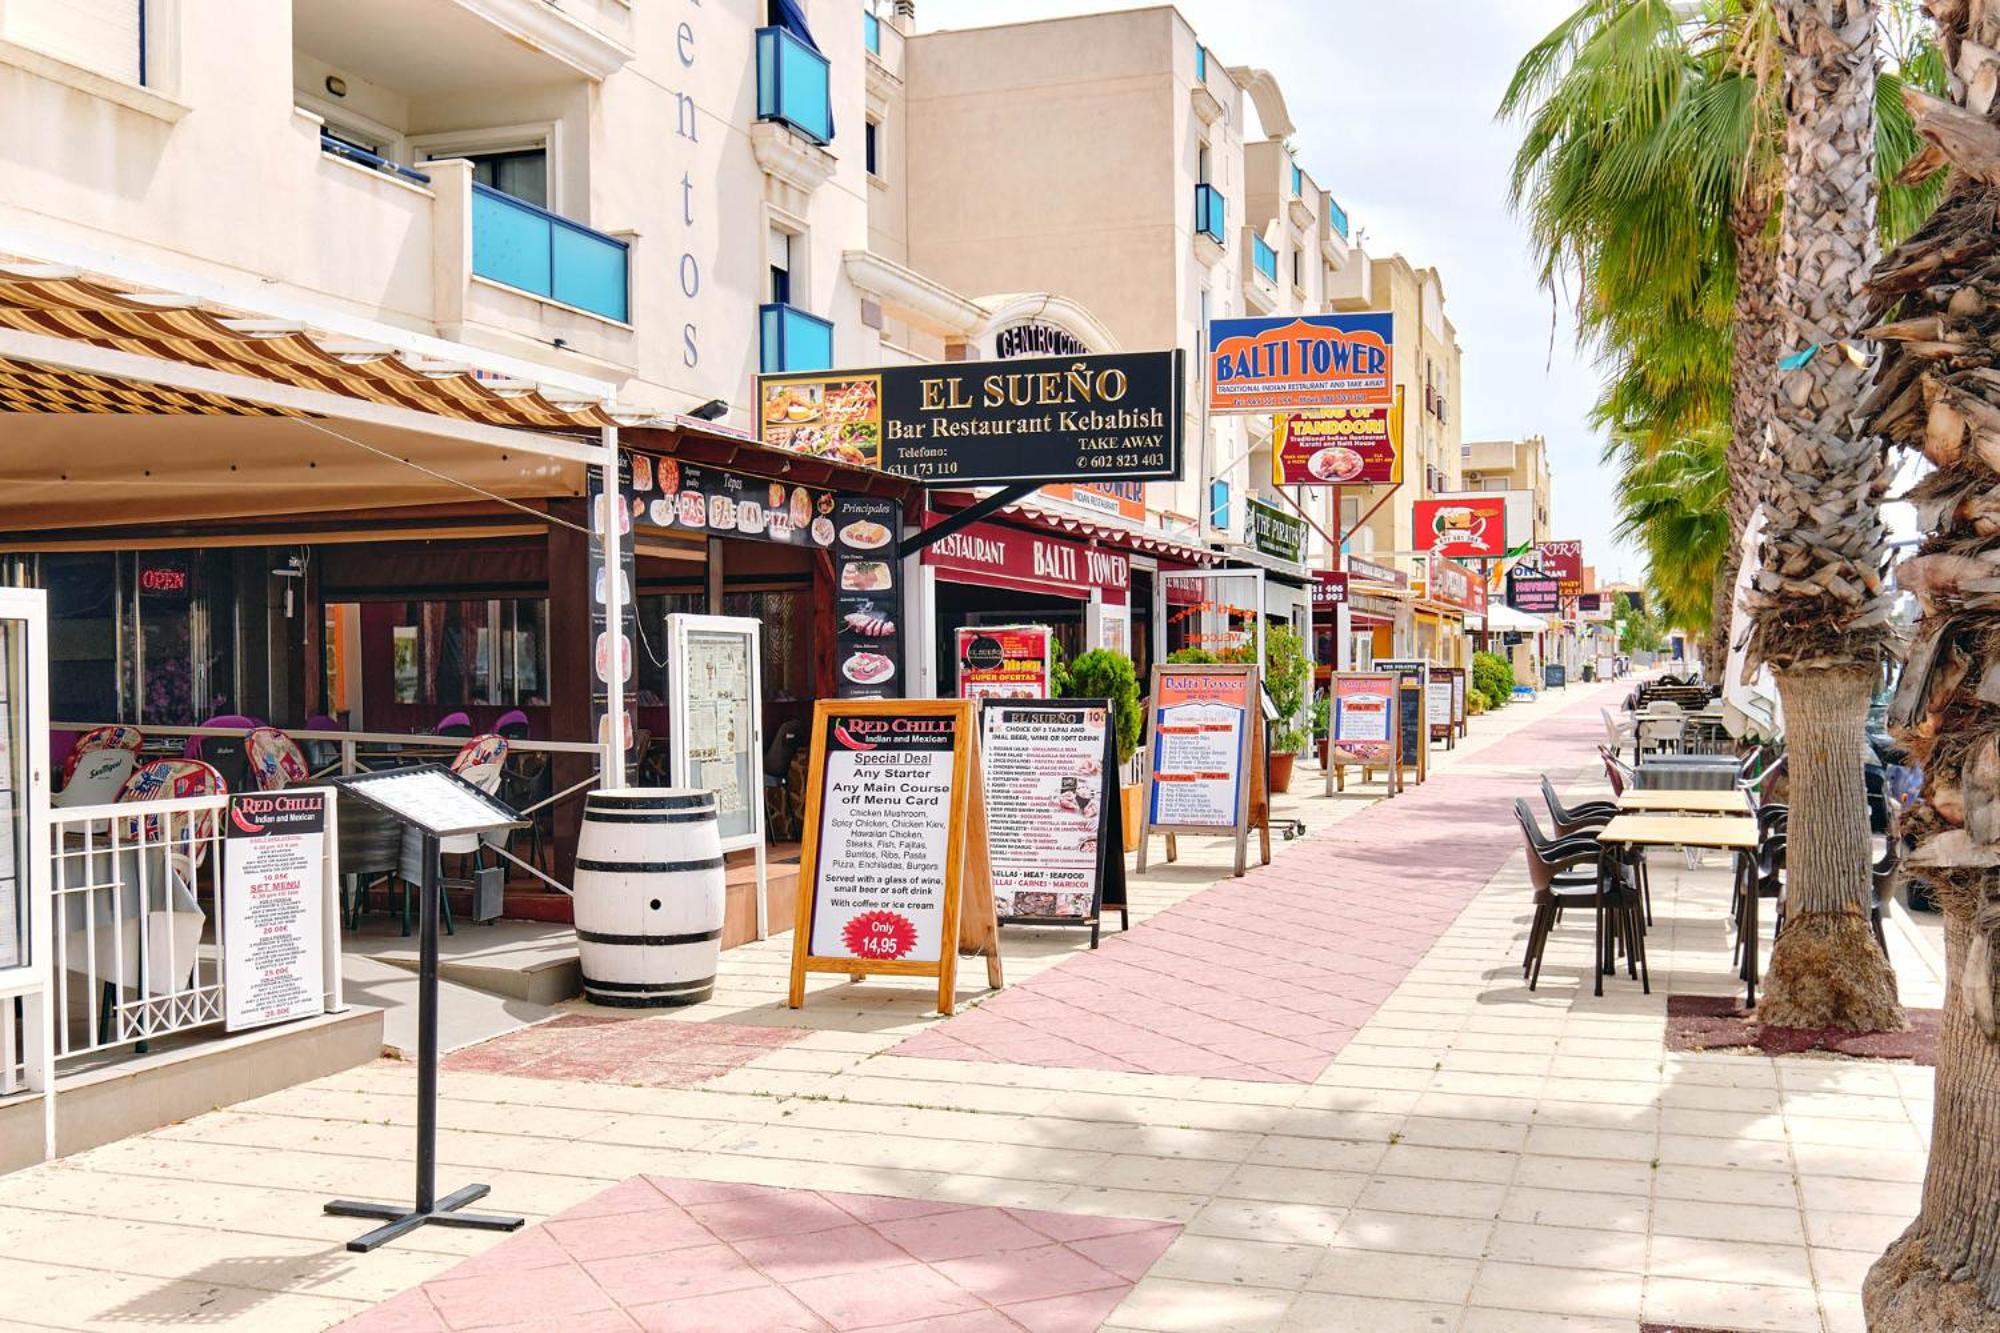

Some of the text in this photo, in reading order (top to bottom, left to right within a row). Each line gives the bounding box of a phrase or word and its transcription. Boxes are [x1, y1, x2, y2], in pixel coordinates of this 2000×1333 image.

[1002, 325, 1055, 358] CENTRO
[1216, 339, 1386, 381] BALTI TOWER
[919, 362, 1128, 411] EL SUEÑO
[1218, 384, 1260, 393] TRADITIONAL
[1262, 383, 1287, 391] INDIAN
[1288, 381, 1329, 390] RESTAURANT
[1347, 380, 1363, 388] TAKE
[887, 408, 1164, 440] Bar Restaurant Kebabish
[1290, 419, 1386, 436] TANDOORI
[1079, 434, 1163, 451] TAKE AWAY
[898, 447, 948, 459] Telefono:
[1090, 453, 1164, 469] 602 823 403
[911, 462, 934, 475] 173
[937, 462, 958, 474] 110
[842, 503, 890, 514] Principales
[1033, 541, 1077, 581] BALTI
[1084, 550, 1128, 587] TOWER
[143, 569, 185, 589] OPEN
[970, 673, 1037, 681] SUPER OFERTAS
[1165, 677, 1246, 689] Balti Tower
[1011, 713, 1026, 723] EL
[1031, 712, 1076, 723] SUEÑO
[848, 718, 956, 733] RED CHILLI
[865, 735, 948, 744] Indian and Mexican
[854, 752, 932, 765] Special Deal
[852, 769, 931, 780] Any Starter
[832, 783, 950, 794] Any Main Course
[242, 796, 323, 813] RED CHILLI
[842, 795, 939, 806] off Menu Card
[255, 813, 315, 823] Indian and Mexican
[850, 809, 882, 817] Chicken
[831, 819, 854, 828] Spicy
[855, 820, 889, 828] Chicken,
[892, 820, 925, 828] Chicken
[851, 830, 924, 839] Hawaiian Chicken,
[877, 841, 896, 849] Fish,
[899, 841, 927, 850] Fajitas,
[845, 850, 927, 859] Burritos, Ribs, Pasta
[858, 861, 906, 870] Enchiladas,
[906, 862, 939, 872] Burgers
[825, 874, 856, 883] Served
[857, 874, 876, 883] with
[885, 875, 908, 886] glass
[909, 876, 919, 885] of
[920, 877, 944, 886] wine,
[1023, 870, 1085, 879] MEAT SEAFOOD
[250, 881, 301, 893] SET MENU
[834, 885, 933, 895] small beer or soft drink
[1052, 880, 1089, 888] MARISCOS
[830, 899, 850, 908] With
[851, 900, 880, 908] coffee
[880, 901, 891, 909] or
[906, 902, 934, 910] cream
[871, 922, 895, 934] Only
[862, 938, 898, 955] 14,95
